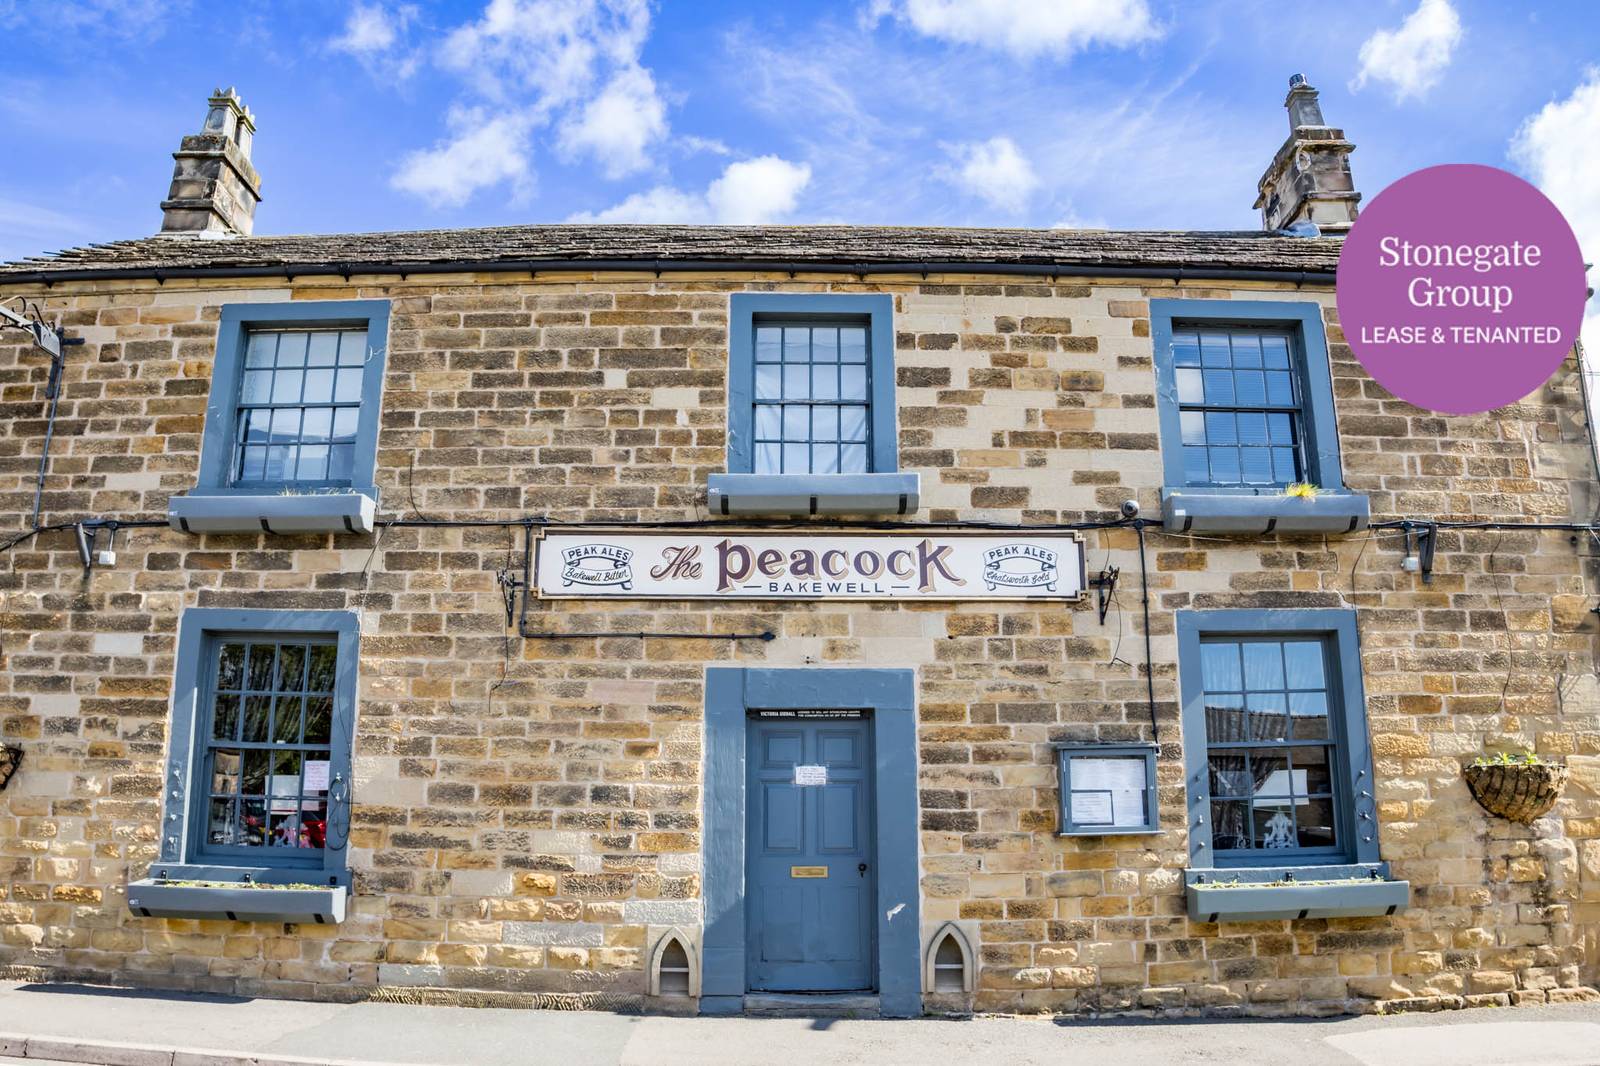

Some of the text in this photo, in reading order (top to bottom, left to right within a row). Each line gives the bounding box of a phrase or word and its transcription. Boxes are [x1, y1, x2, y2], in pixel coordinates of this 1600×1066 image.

[568, 546, 630, 561] PEAK ALES
[988, 546, 1053, 561] PEAK ALES
[650, 544, 703, 581] The
[565, 567, 630, 582] Bakewell Bitter
[986, 571, 1050, 585] Chatsworth Gold
[769, 582, 885, 593] BAKEWELL
